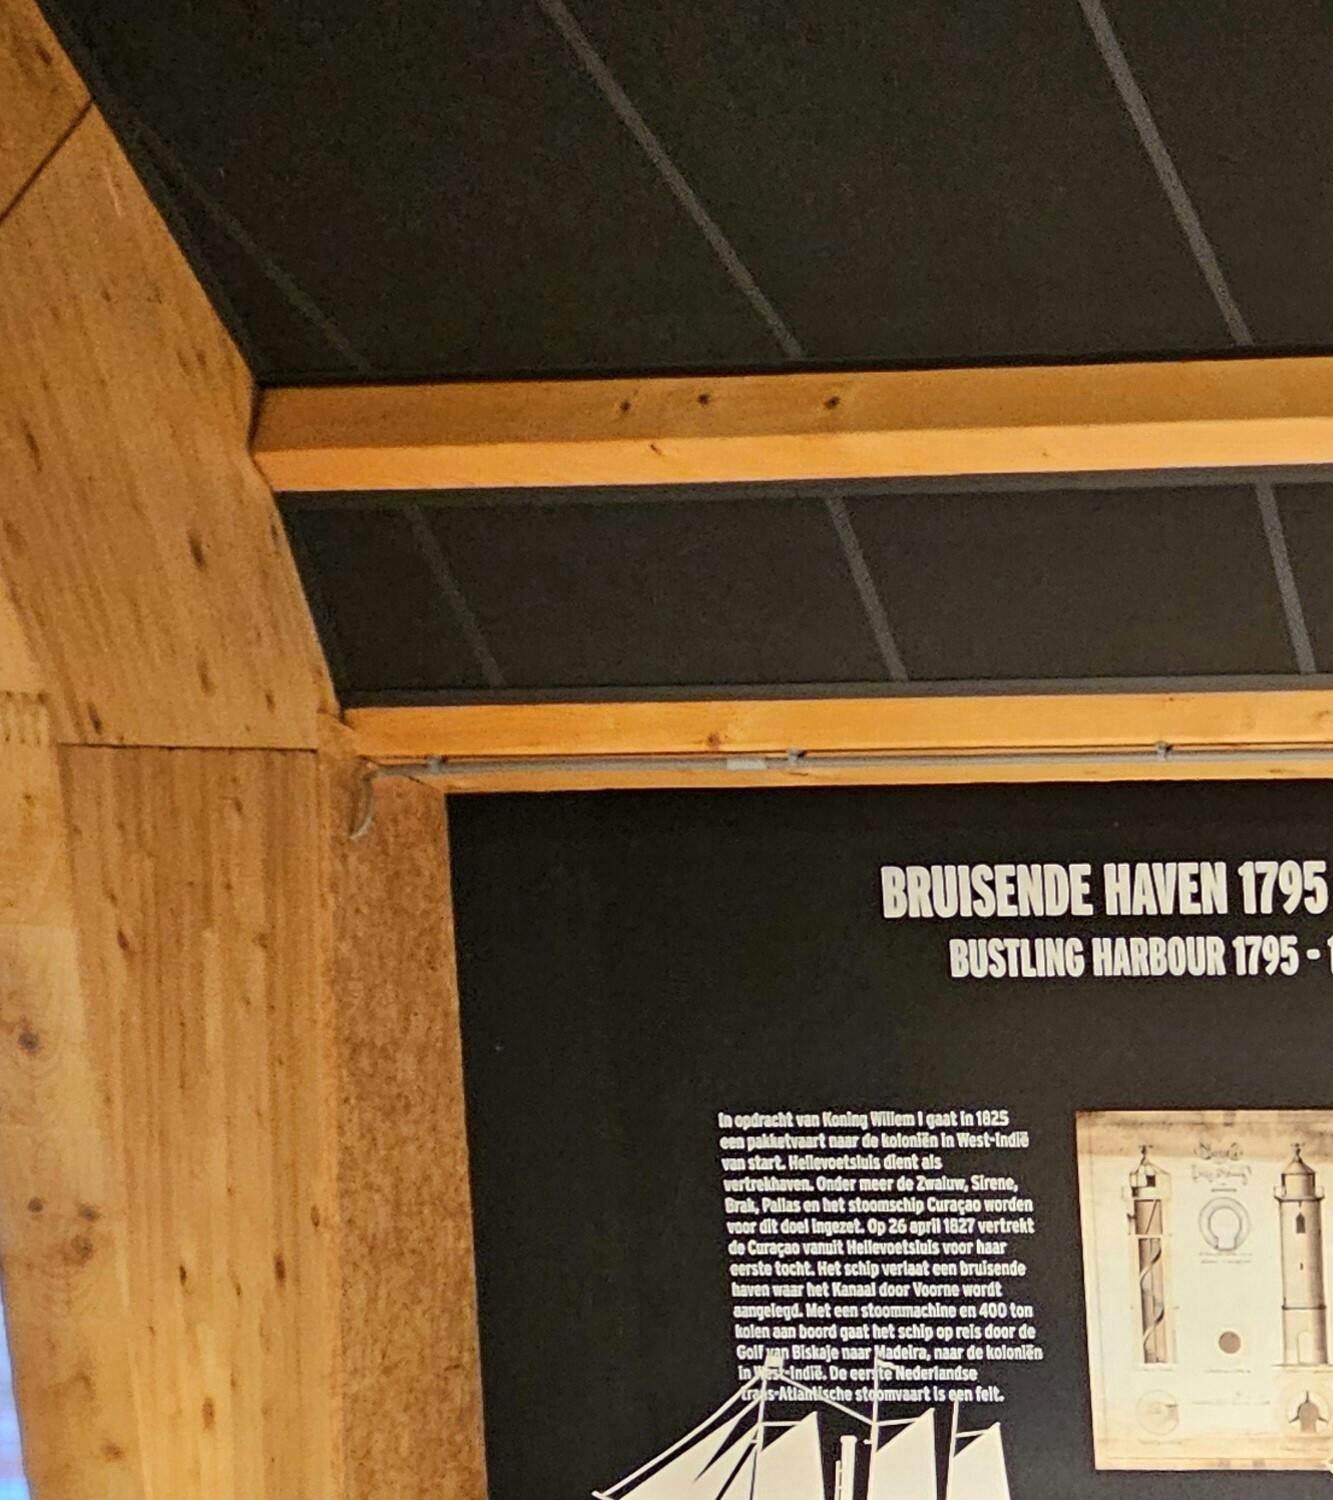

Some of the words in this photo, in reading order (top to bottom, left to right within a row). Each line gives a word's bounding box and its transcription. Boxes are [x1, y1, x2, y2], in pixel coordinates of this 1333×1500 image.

[881, 865, 1094, 917] BRUISENDE
[1103, 862, 1228, 914] HAVEN
[1237, 861, 1329, 914] 1795
[949, 938, 1085, 977] BUSTLING
[1091, 937, 1227, 975] HARBOUR
[1232, 936, 1299, 975] 1795
[718, 1112, 733, 1127] In
[734, 1112, 794, 1130] opdracht
[795, 1114, 820, 1127] van
[822, 1110, 869, 1129] Koning
[870, 1110, 916, 1126] Willem
[917, 1110, 924, 1126] I
[925, 1110, 958, 1129] gaat
[959, 1110, 974, 1126] in
[975, 1110, 1010, 1126] 1825
[721, 1158, 746, 1171] van
[747, 1154, 787, 1169] start.
[883, 1153, 919, 1170] dient
[921, 1153, 943, 1169] als
[816, 1176, 857, 1191] Onder
[859, 1177, 894, 1190] meer
[896, 1175, 914, 1190] de
[916, 1174, 969, 1191] Zwaluw,
[970, 1174, 1019, 1192] Sirene,
[726, 1221, 757, 1233] voor
[759, 1218, 779, 1233] dit
[780, 1218, 810, 1233] doel
[811, 1218, 865, 1236] ingezet.
[867, 1218, 886, 1236] Op
[888, 1218, 908, 1234] 26
[909, 1218, 942, 1236] april
[943, 1217, 976, 1233] 1827
[977, 1217, 1035, 1233] vertrekt
